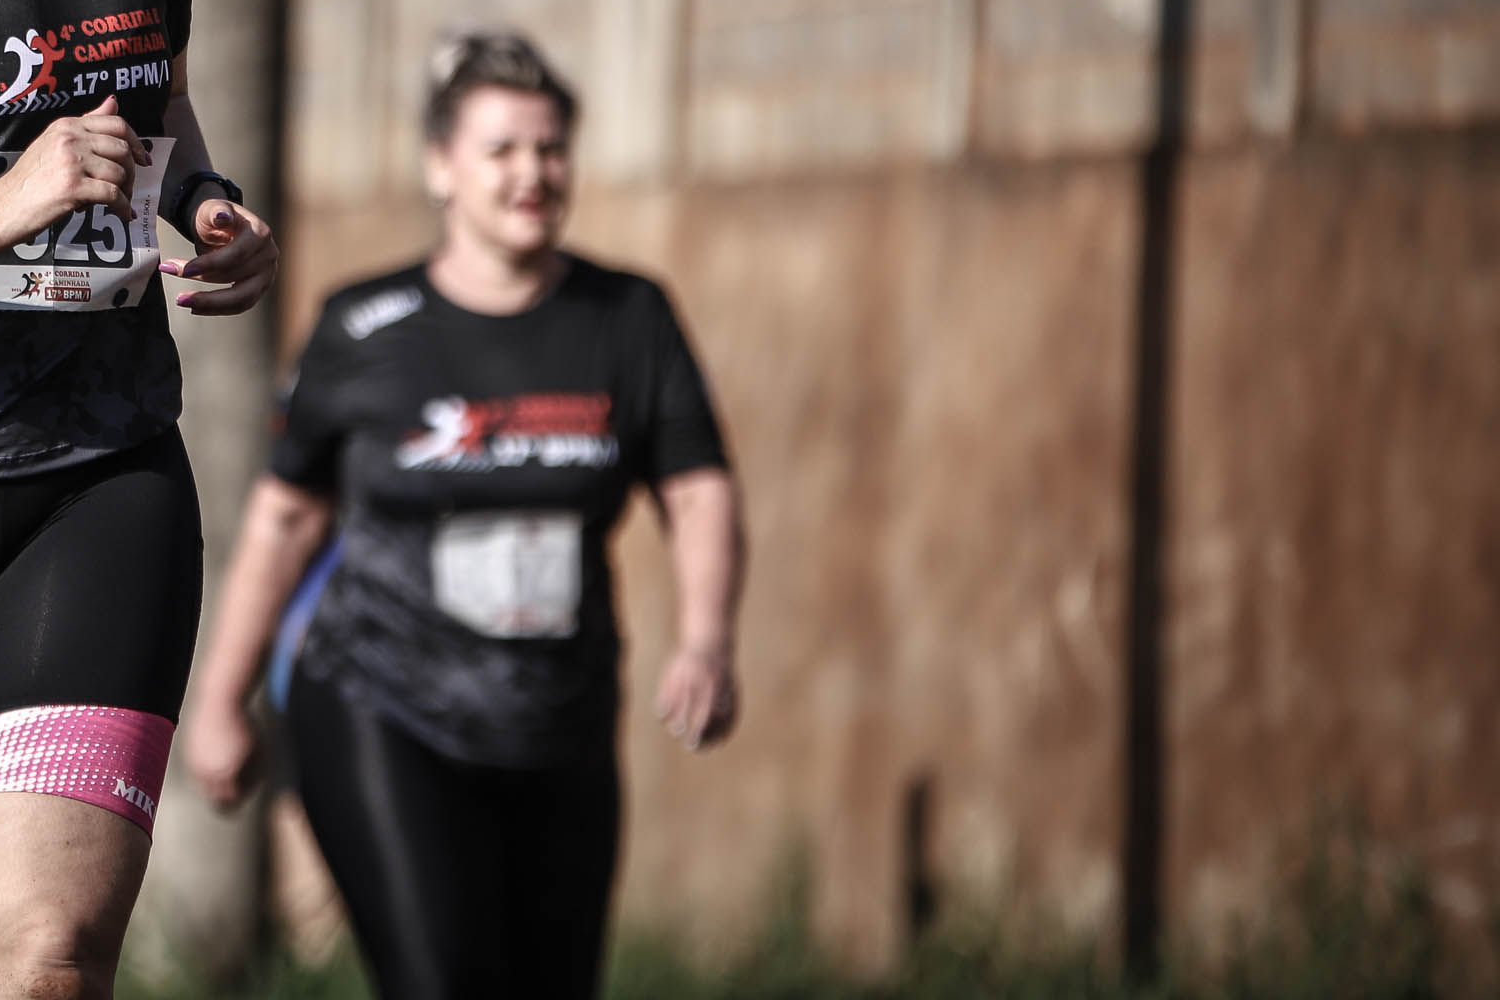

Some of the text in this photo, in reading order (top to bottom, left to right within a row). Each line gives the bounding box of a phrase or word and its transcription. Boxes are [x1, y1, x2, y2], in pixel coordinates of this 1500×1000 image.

[81, 10, 155, 36] CORRIDA
[74, 33, 166, 63] CAMINHADA
[116, 59, 170, 91] BPM/I
[49, 279, 90, 287] CAMINHADA
[54, 270, 85, 278] CORRIDA
[112, 779, 156, 822] MIK
